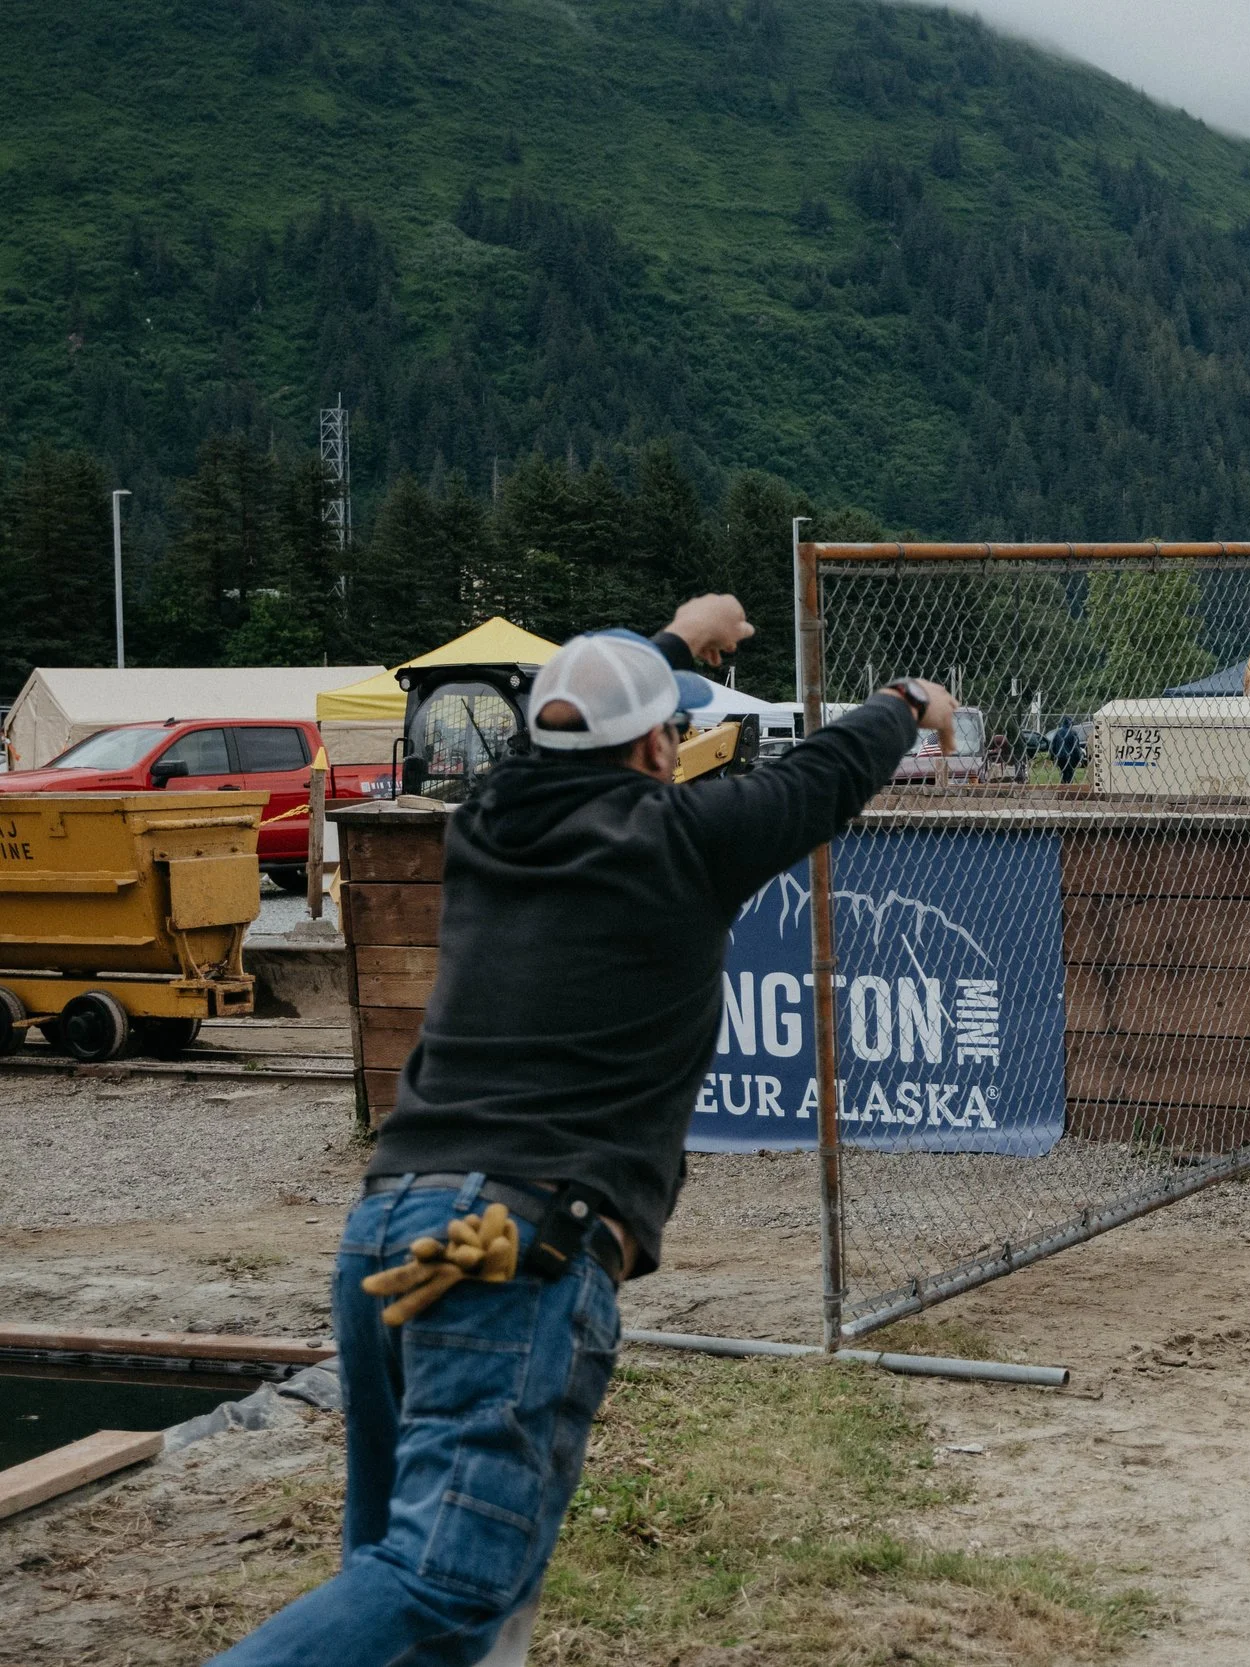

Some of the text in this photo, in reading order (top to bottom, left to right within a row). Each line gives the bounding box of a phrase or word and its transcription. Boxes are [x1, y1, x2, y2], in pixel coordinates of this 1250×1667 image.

[1114, 745, 1161, 761] HP375
[1124, 728, 1161, 744] P425
[715, 970, 943, 1064] NGON
[956, 978, 1000, 1066] MINE
